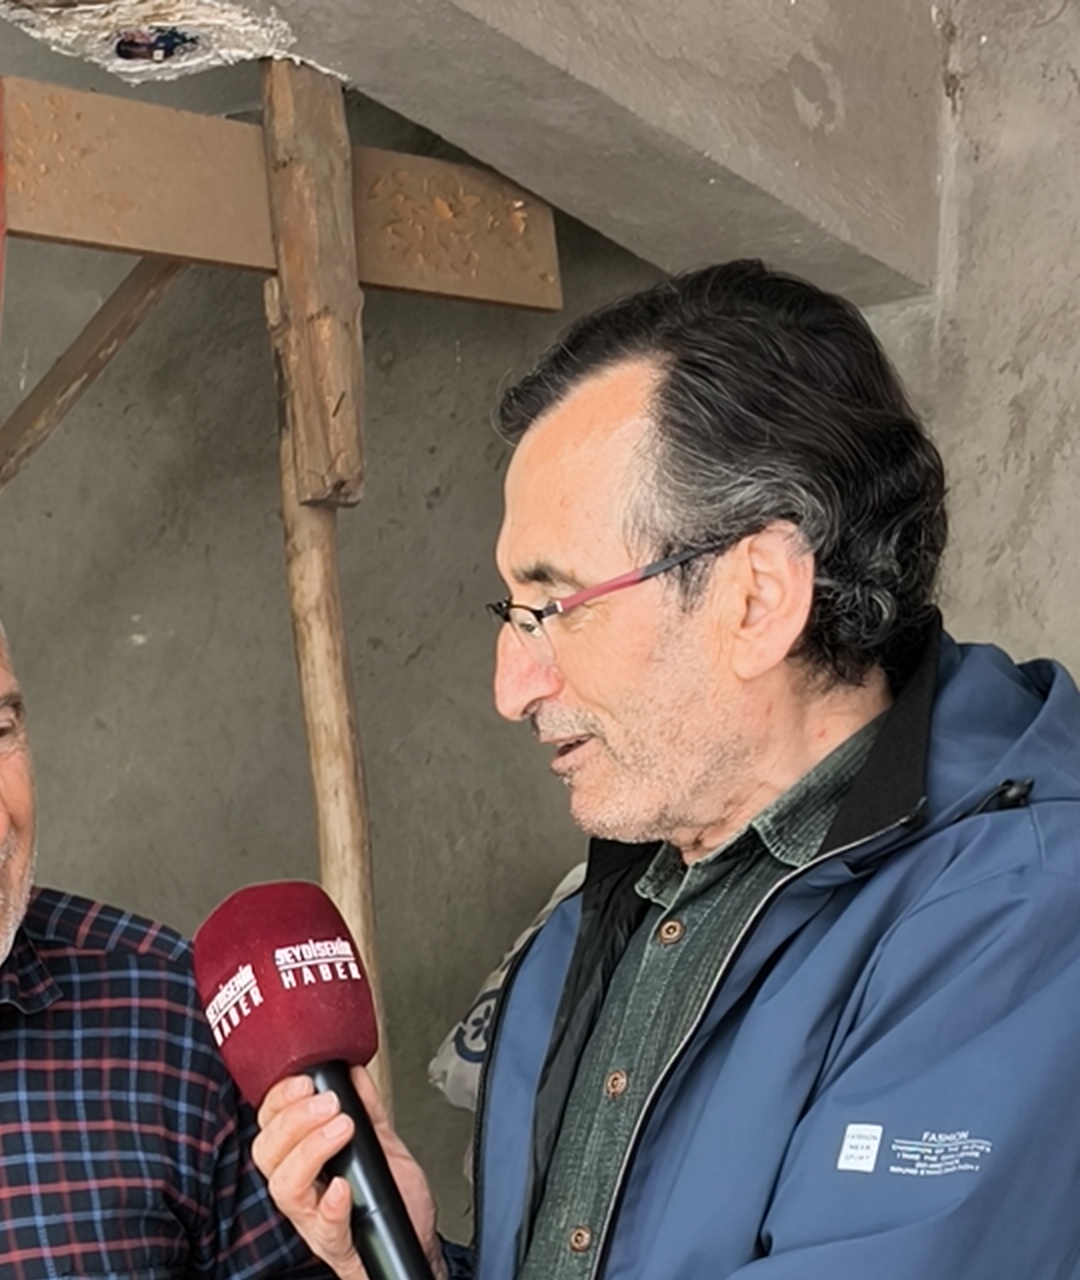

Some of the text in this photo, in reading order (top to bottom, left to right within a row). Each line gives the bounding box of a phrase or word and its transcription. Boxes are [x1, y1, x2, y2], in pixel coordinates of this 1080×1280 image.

[280, 961, 361, 989] HABER
[213, 986, 265, 1047] HABER
[921, 1130, 969, 1143] FASHION
